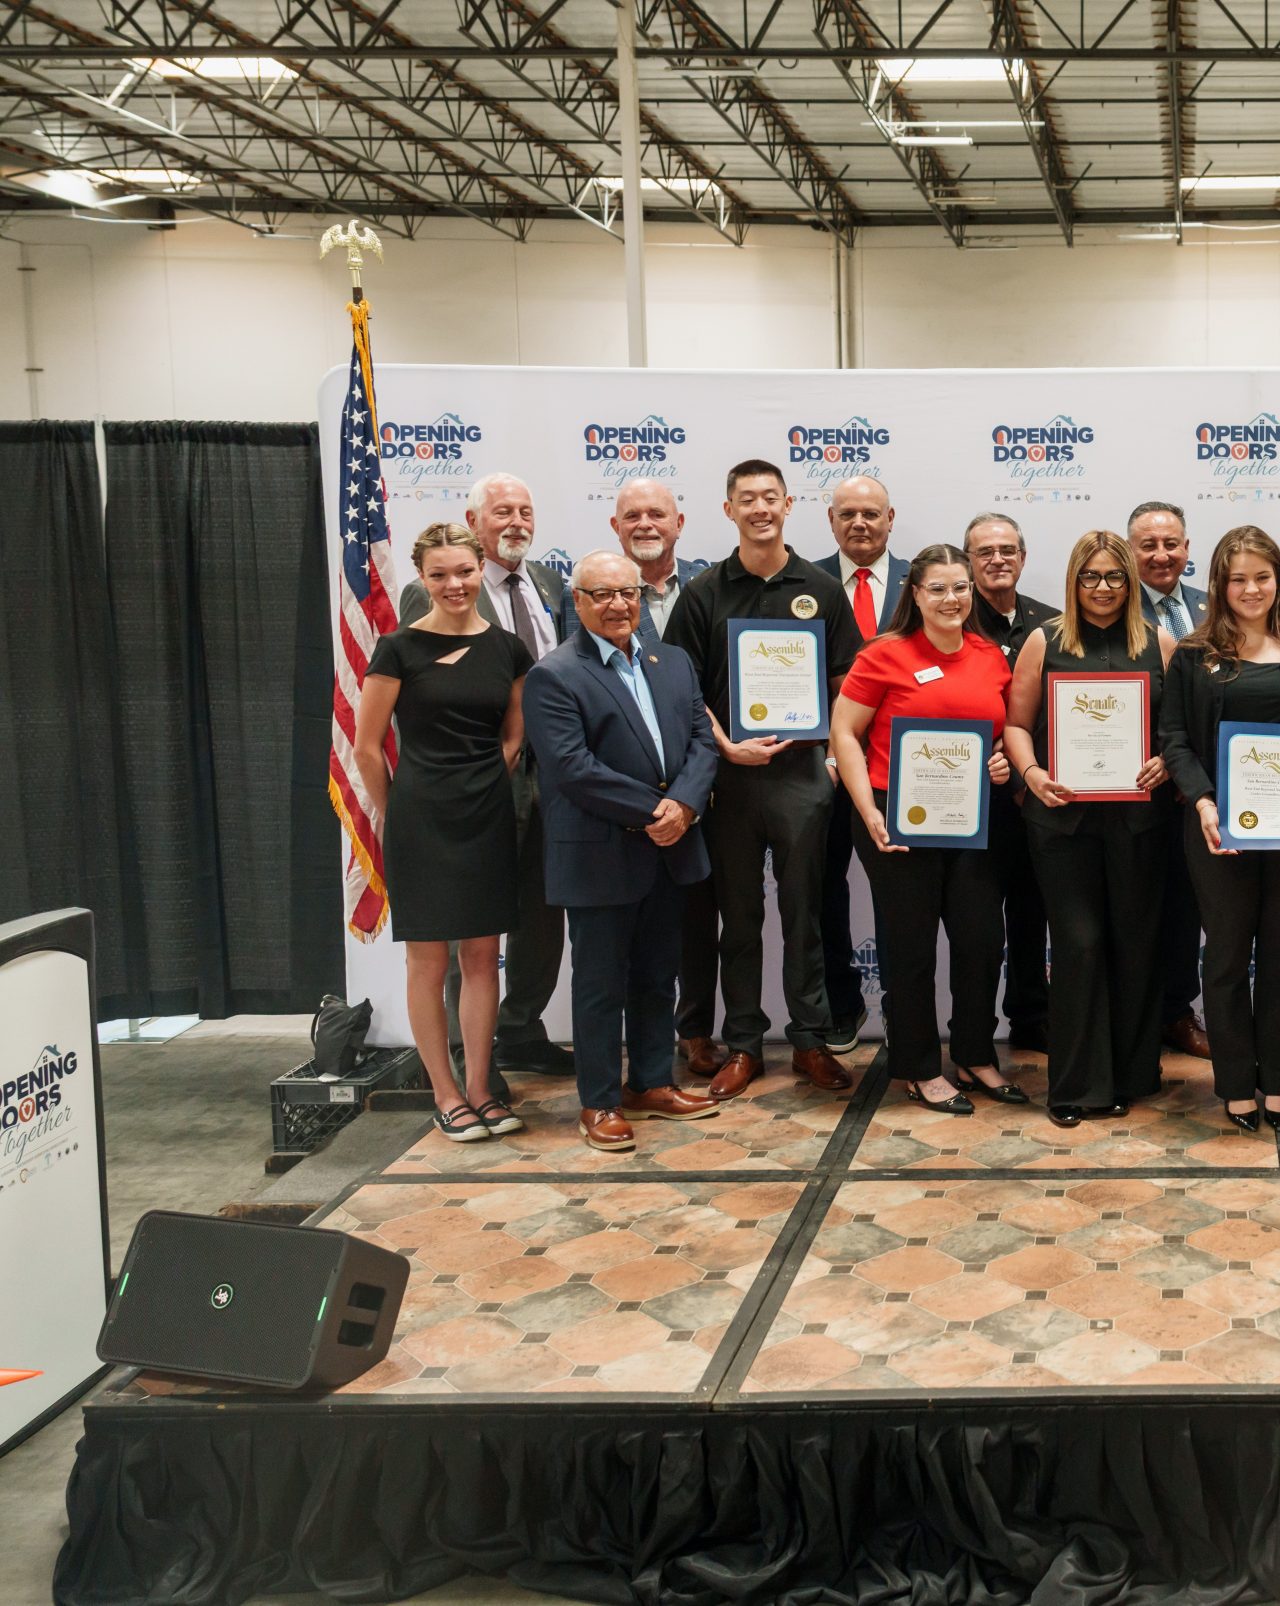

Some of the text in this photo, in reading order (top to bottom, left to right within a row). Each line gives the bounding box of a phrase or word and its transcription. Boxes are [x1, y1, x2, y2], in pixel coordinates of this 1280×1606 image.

[380, 421, 482, 443] OPENING
[584, 423, 686, 444] OPENING
[788, 425, 890, 446] OPENING
[992, 425, 1094, 444] OPENING
[381, 442, 462, 459] DOORS
[585, 444, 666, 461] DOORS
[790, 445, 870, 463] DOORS
[993, 445, 1074, 462] DOORS
[1197, 443, 1277, 460] DOORS
[394, 456, 474, 486] Together
[599, 457, 678, 487] Together
[803, 458, 881, 488] Together
[1006, 459, 1086, 487] Together
[750, 640, 806, 658] Assembly
[1071, 693, 1124, 713] Senate
[911, 742, 971, 761] Assembly
[0, 1051, 78, 1108] PENING
[0, 1083, 62, 1132] OORS
[0, 1102, 73, 1164] Together
